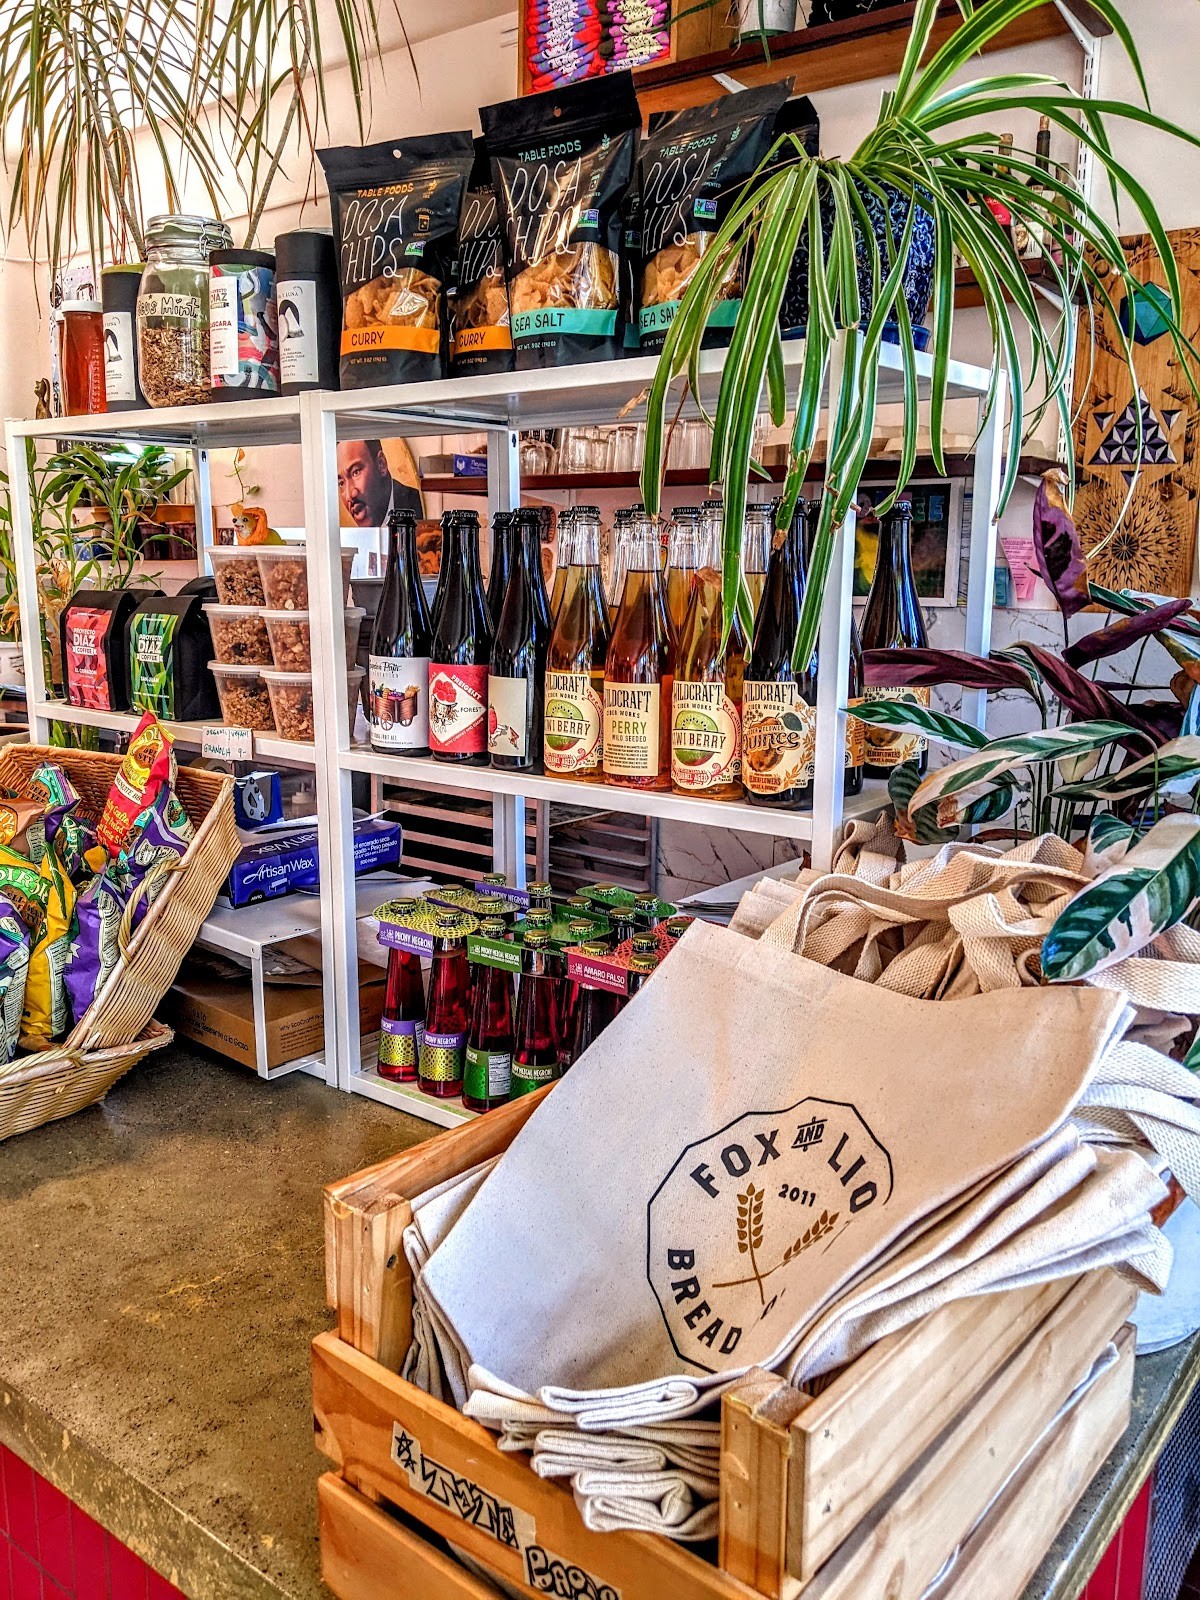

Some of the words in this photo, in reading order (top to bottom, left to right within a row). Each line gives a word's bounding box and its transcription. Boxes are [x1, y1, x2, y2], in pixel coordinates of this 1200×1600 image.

[518, 148, 546, 163] TABLE
[548, 140, 581, 157] FOODS
[660, 144, 686, 158] TABLE
[686, 134, 717, 151] FOODS
[357, 188, 382, 198] TABLE
[384, 183, 414, 196] FOODS
[507, 157, 582, 214] DOSA
[342, 195, 409, 241] DOSA
[641, 194, 696, 258] HIPS
[514, 315, 533, 333] SEA
[534, 313, 565, 329] SALT
[660, 306, 679, 324] SAL
[351, 331, 385, 346] CURRY
[459, 332, 486, 347] CURRY
[451, 674, 483, 700] FREIGEIST
[546, 674, 588, 696] ILDCRAFT
[691, 703, 712, 711] WORKS
[557, 720, 591, 736] BERRY
[612, 720, 647, 735] PERRY
[689, 733, 726, 749] BERRY
[242, 857, 315, 885] ArtisanWax
[394, 931, 412, 945] PHONY
[412, 934, 433, 950] NEGRONI
[583, 966, 606, 979] AMARO
[606, 971, 625, 985] FALSO
[690, 1129, 781, 1198] FOX
[794, 1123, 824, 1146] AND
[778, 1184, 816, 1207] 2011
[667, 1248, 742, 1355] BREAD
